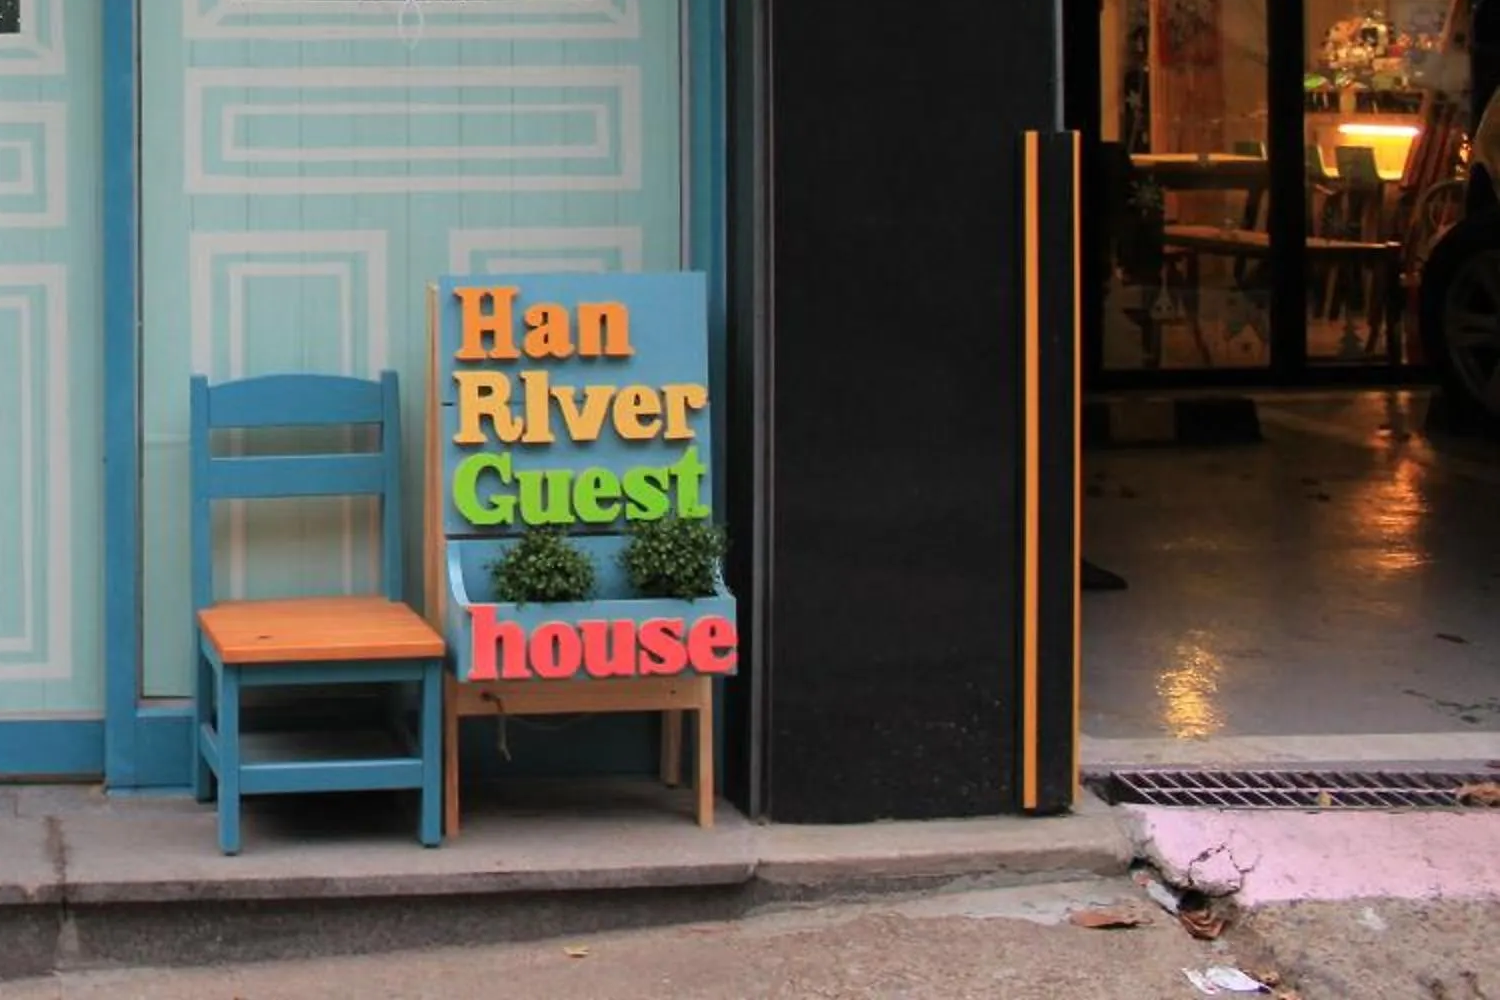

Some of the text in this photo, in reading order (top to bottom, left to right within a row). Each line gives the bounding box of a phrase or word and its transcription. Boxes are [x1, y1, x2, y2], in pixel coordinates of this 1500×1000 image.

[453, 286, 635, 361] Han
[452, 446, 710, 527] Guest
[467, 605, 739, 682] house
